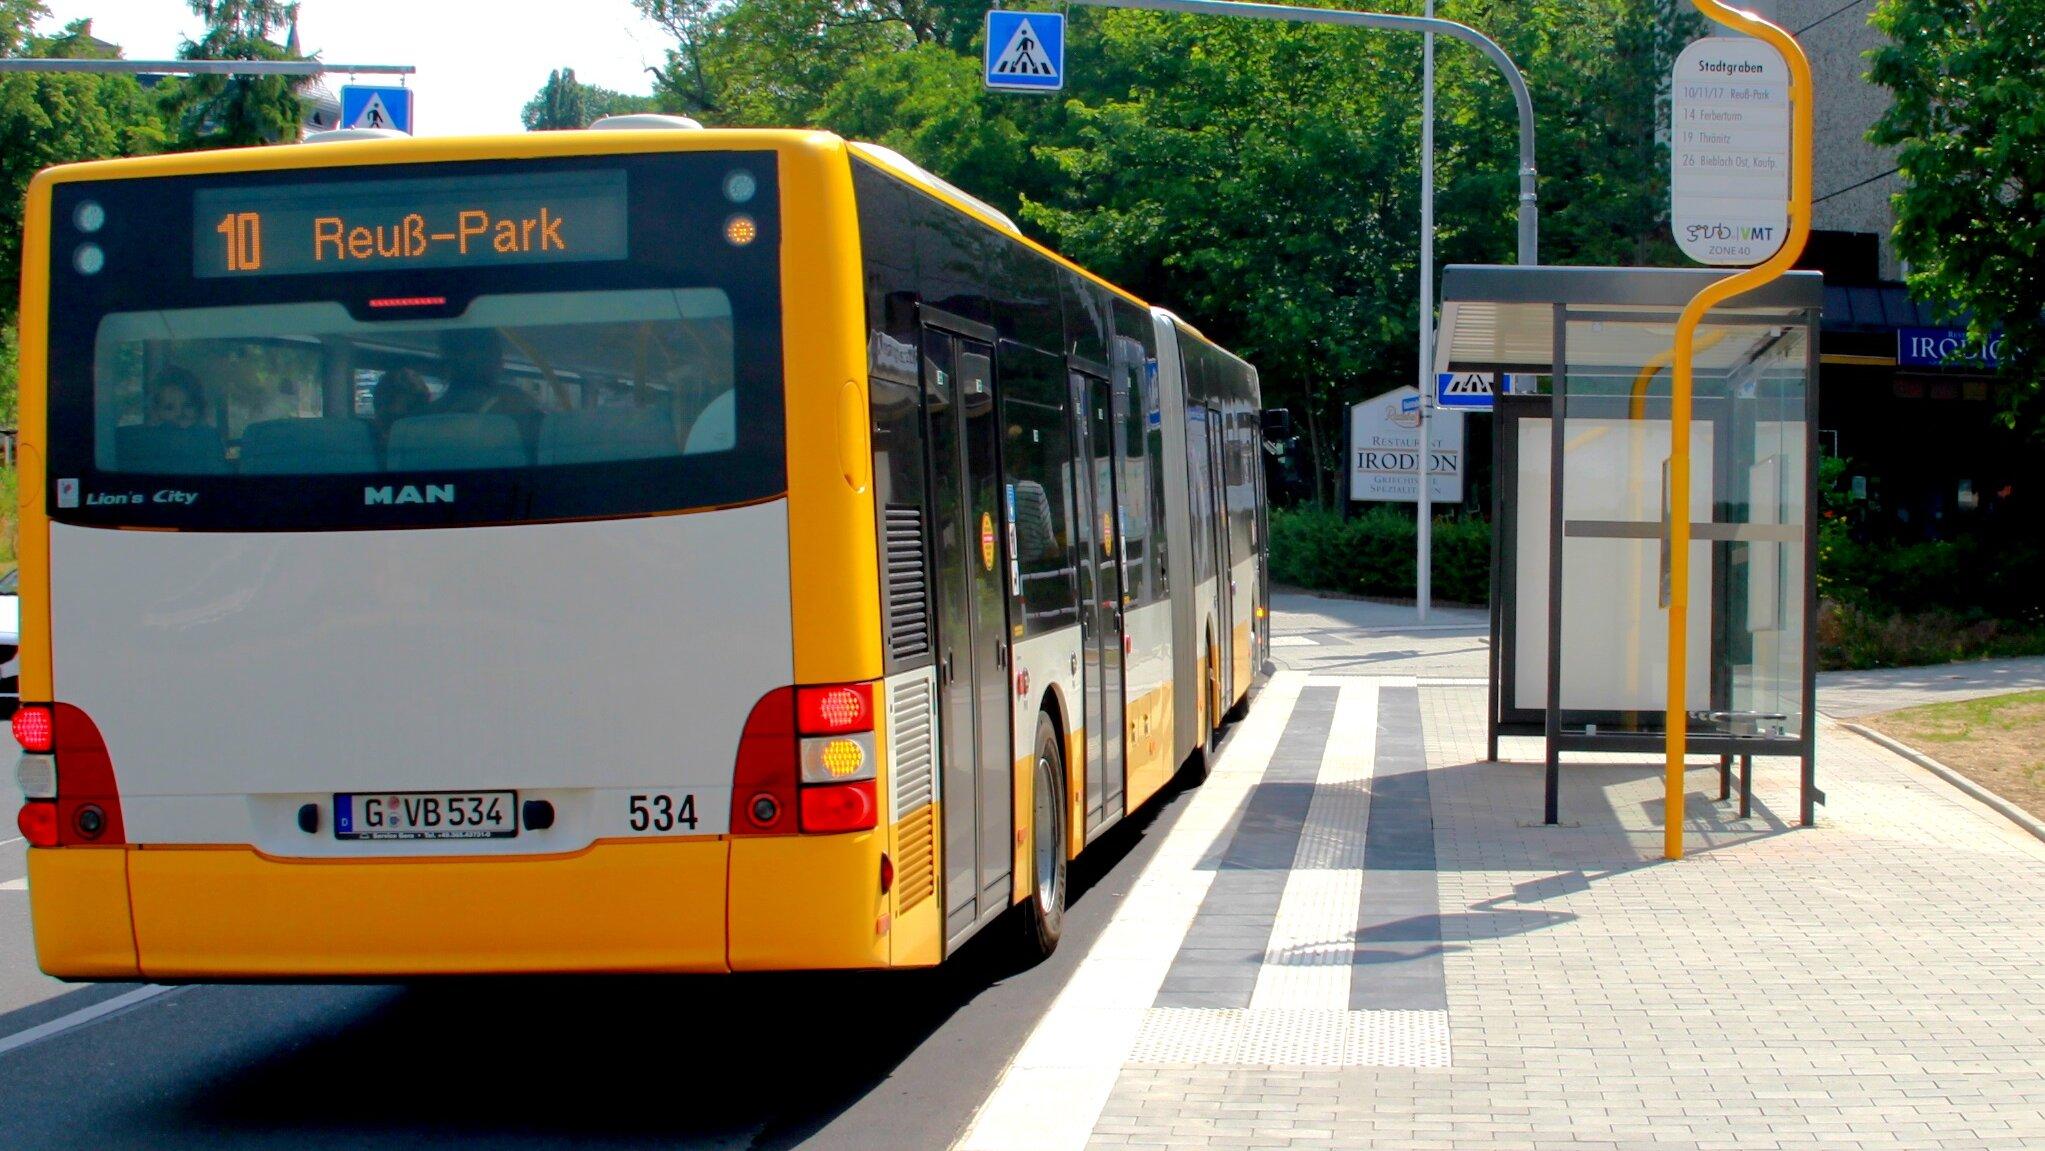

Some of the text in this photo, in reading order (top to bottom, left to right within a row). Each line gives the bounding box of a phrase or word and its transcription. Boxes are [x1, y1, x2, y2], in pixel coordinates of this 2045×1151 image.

[1698, 60, 1763, 75] Stadtgraben
[1684, 86, 1724, 99] 10/11/17
[1683, 107, 1695, 120] 14
[1682, 131, 1693, 144] 19
[1682, 154, 1695, 167] 26
[217, 207, 566, 271] 10 Reuß-Park
[1741, 228, 1773, 241] VMT
[1708, 245, 1751, 256] ZONE 40
[85, 484, 455, 506] Lion's City MAN
[341, 797, 503, 827] D G VB 534
[629, 794, 698, 832] 534
